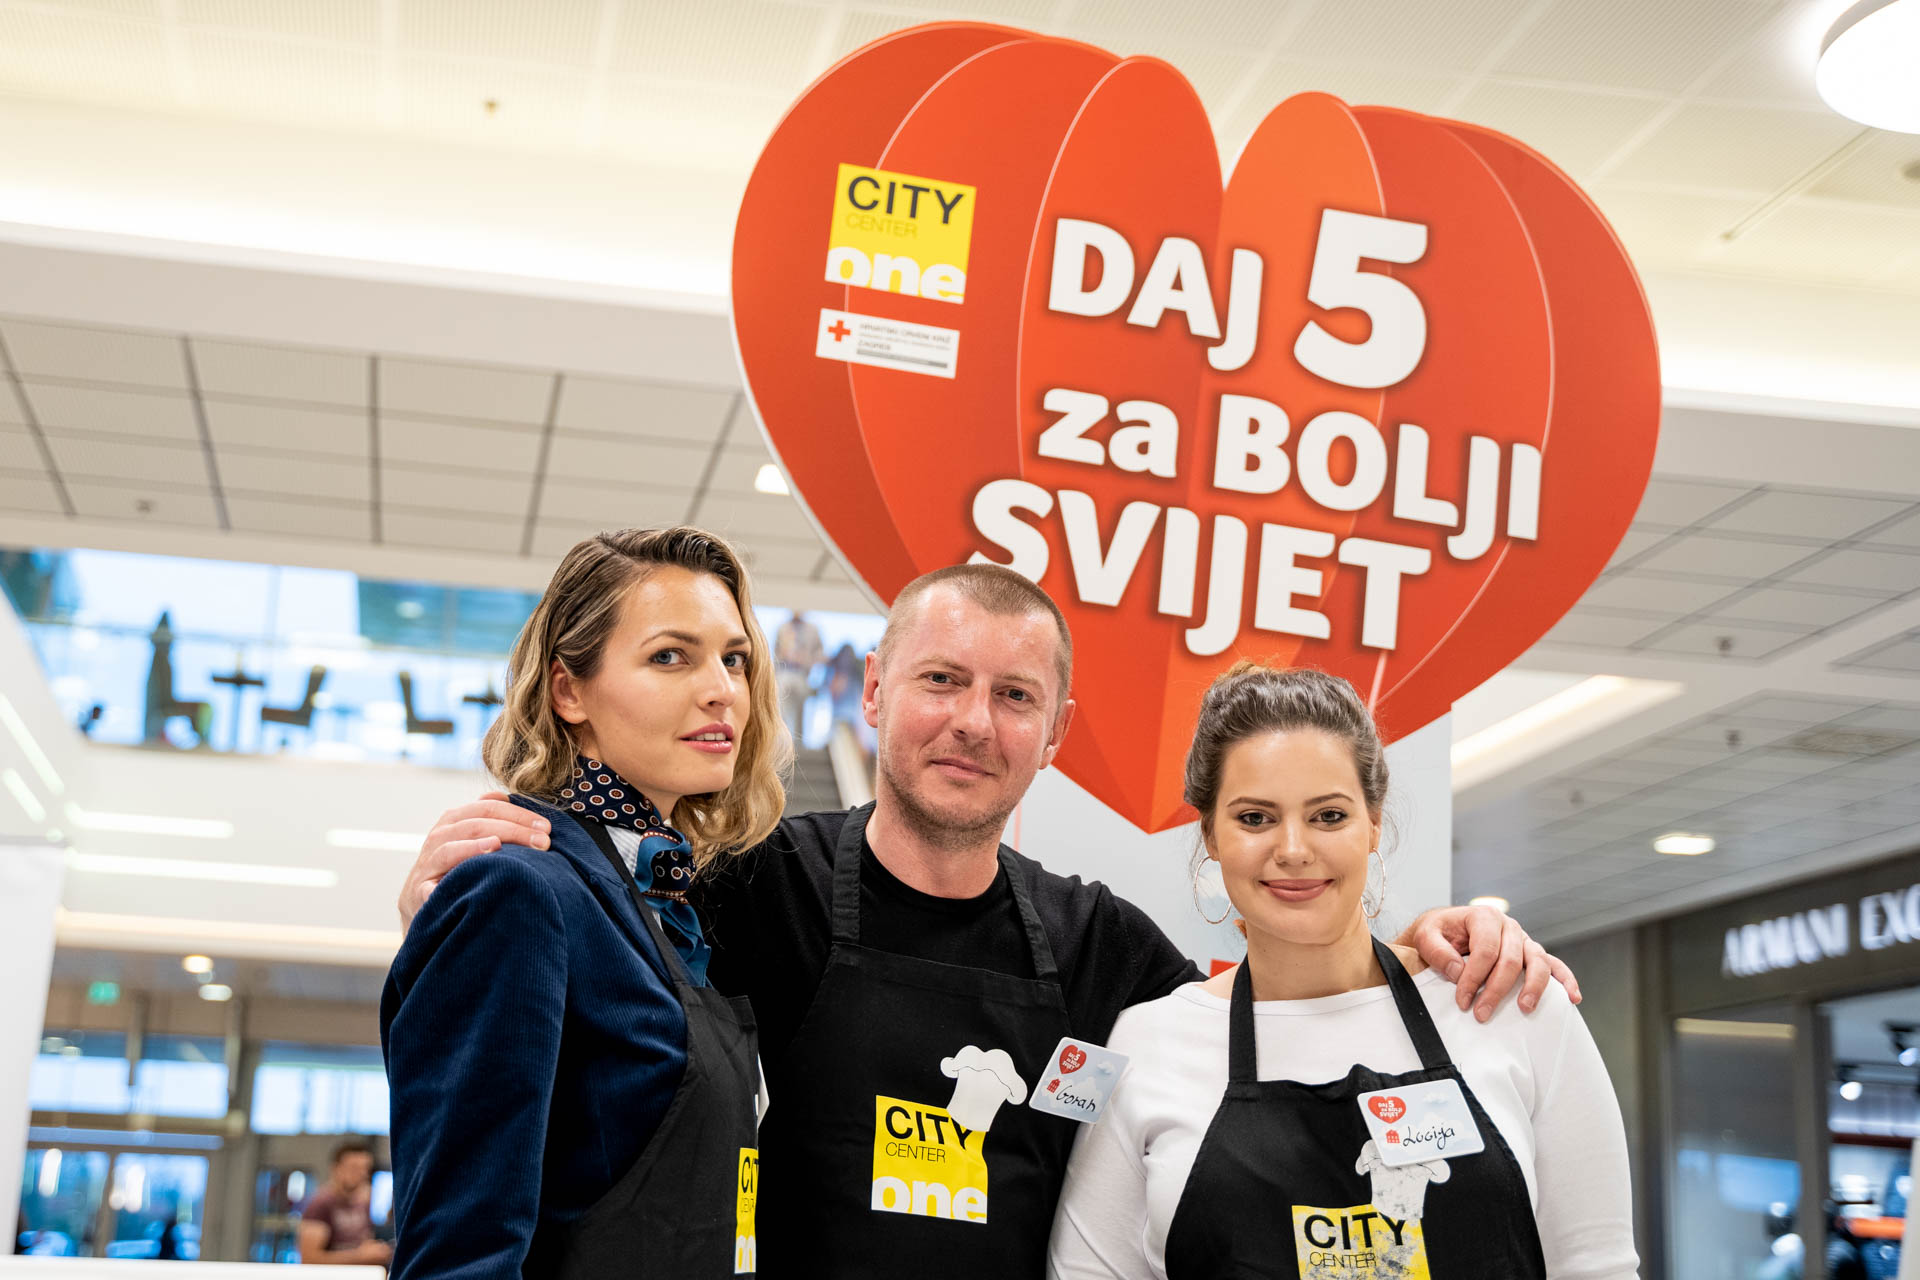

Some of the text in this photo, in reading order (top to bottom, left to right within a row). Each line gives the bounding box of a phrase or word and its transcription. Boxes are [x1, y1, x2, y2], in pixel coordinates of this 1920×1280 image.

[848, 176, 964, 225] CITY
[846, 213, 918, 239] CENTER
[825, 246, 967, 304] one
[1049, 208, 1428, 389] DAJ 5
[1038, 388, 1543, 561] za BOLJI
[966, 479, 1432, 656] SVIJET
[885, 1106, 973, 1151] CITY
[886, 1142, 946, 1163] CENTER
[871, 1176, 987, 1224] one
[1304, 1212, 1406, 1250] CITY
[1310, 1252, 1377, 1268] CENTER
